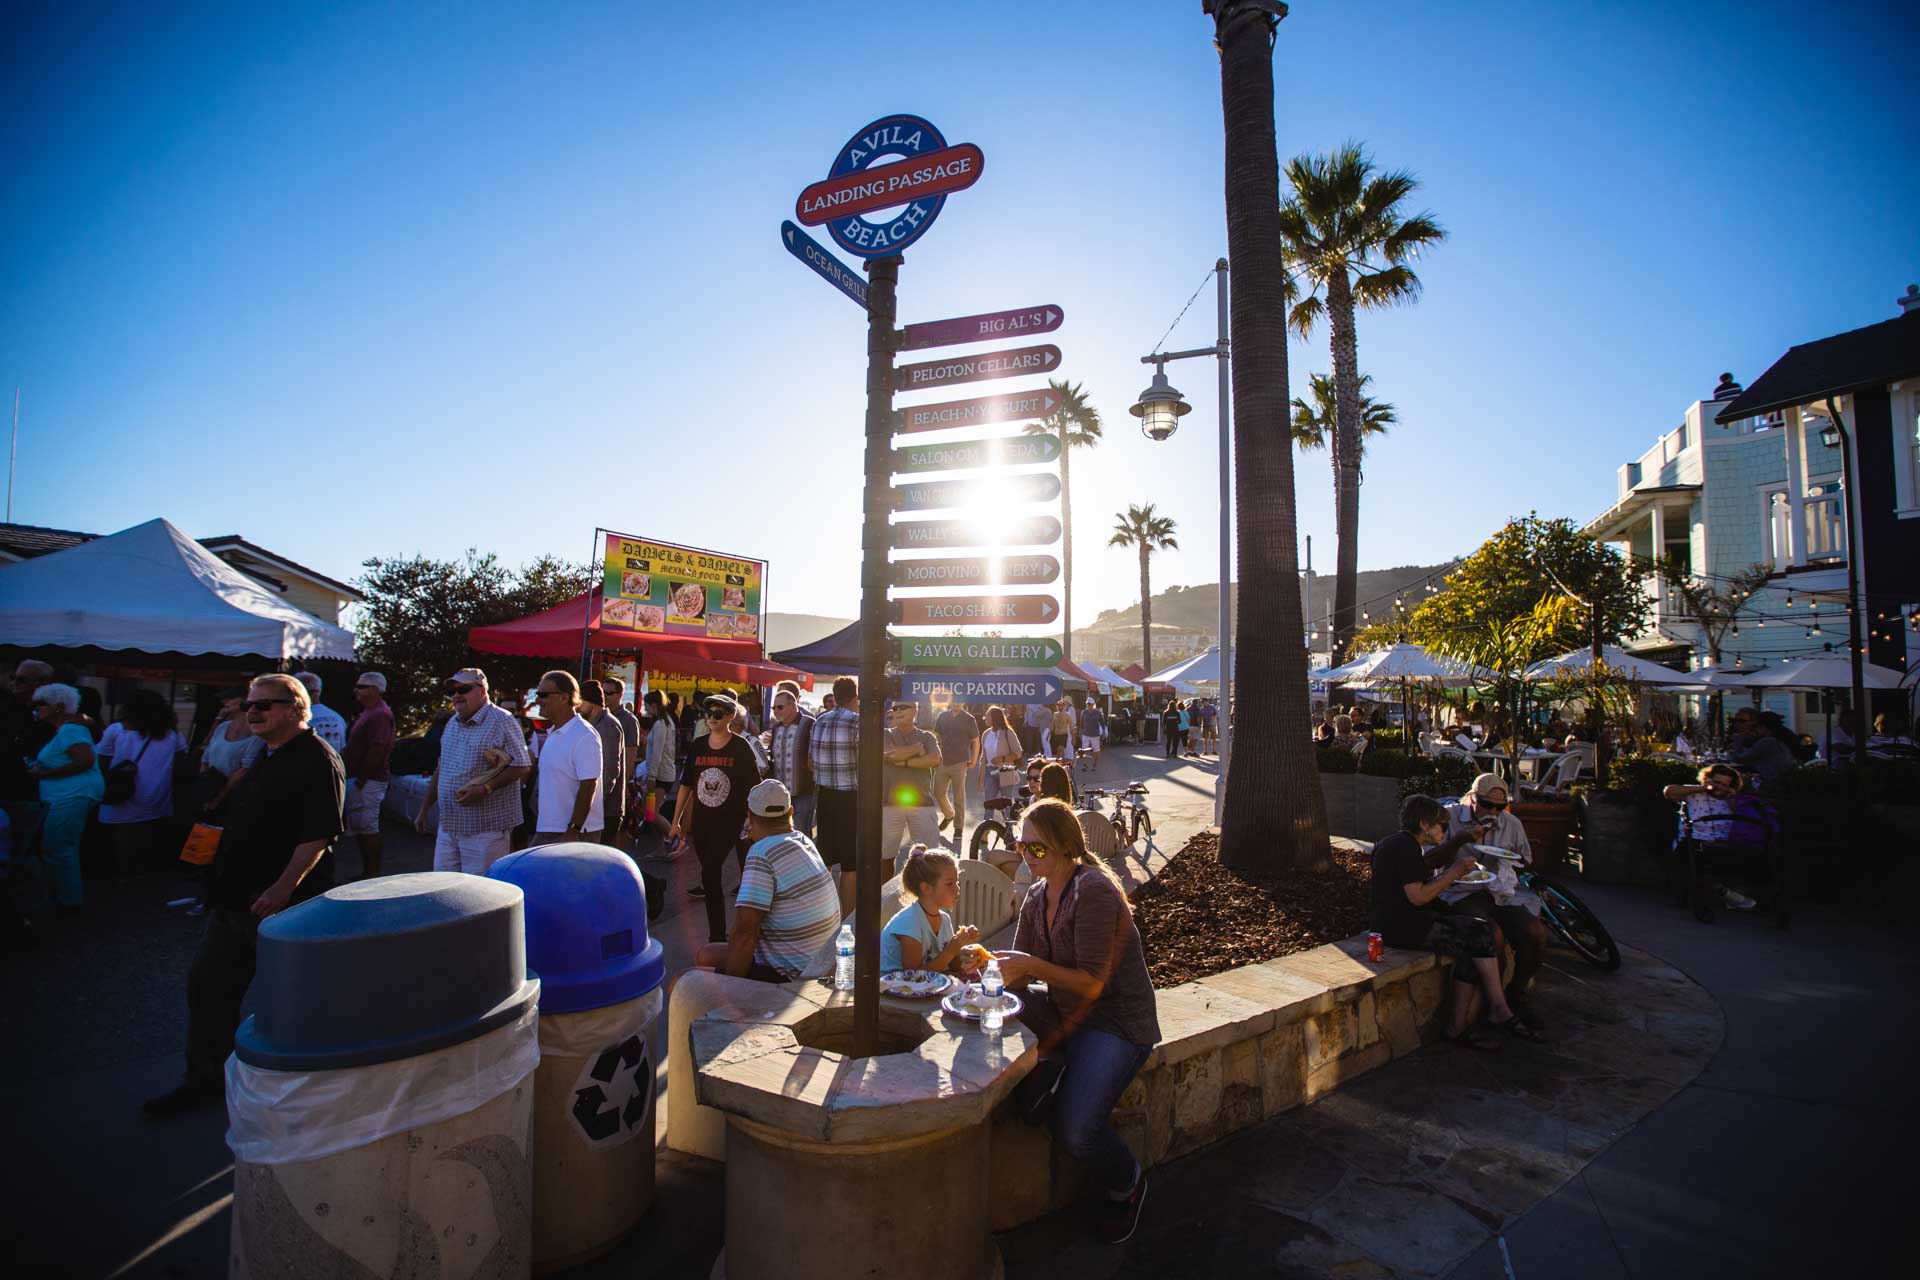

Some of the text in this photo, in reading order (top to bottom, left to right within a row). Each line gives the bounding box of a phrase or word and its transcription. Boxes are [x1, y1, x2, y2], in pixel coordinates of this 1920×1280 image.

[849, 126, 923, 167] AVILA
[803, 157, 972, 213] LANDING PASSAGE
[843, 202, 927, 248] BEACH
[806, 245, 867, 302] OCEAN GRILL
[979, 313, 1042, 334] BIG AL'S
[913, 353, 1041, 383] PELOTON CELLARS
[911, 450, 953, 465] SALON
[686, 554, 694, 566] &
[698, 571, 720, 581] FOOD
[908, 563, 1039, 580] MOROVINO NERY
[925, 604, 1017, 618] TACO SHACK
[913, 644, 1041, 659] SAYVA GALLERY
[912, 682, 1036, 696] PUBLIC PARKING
